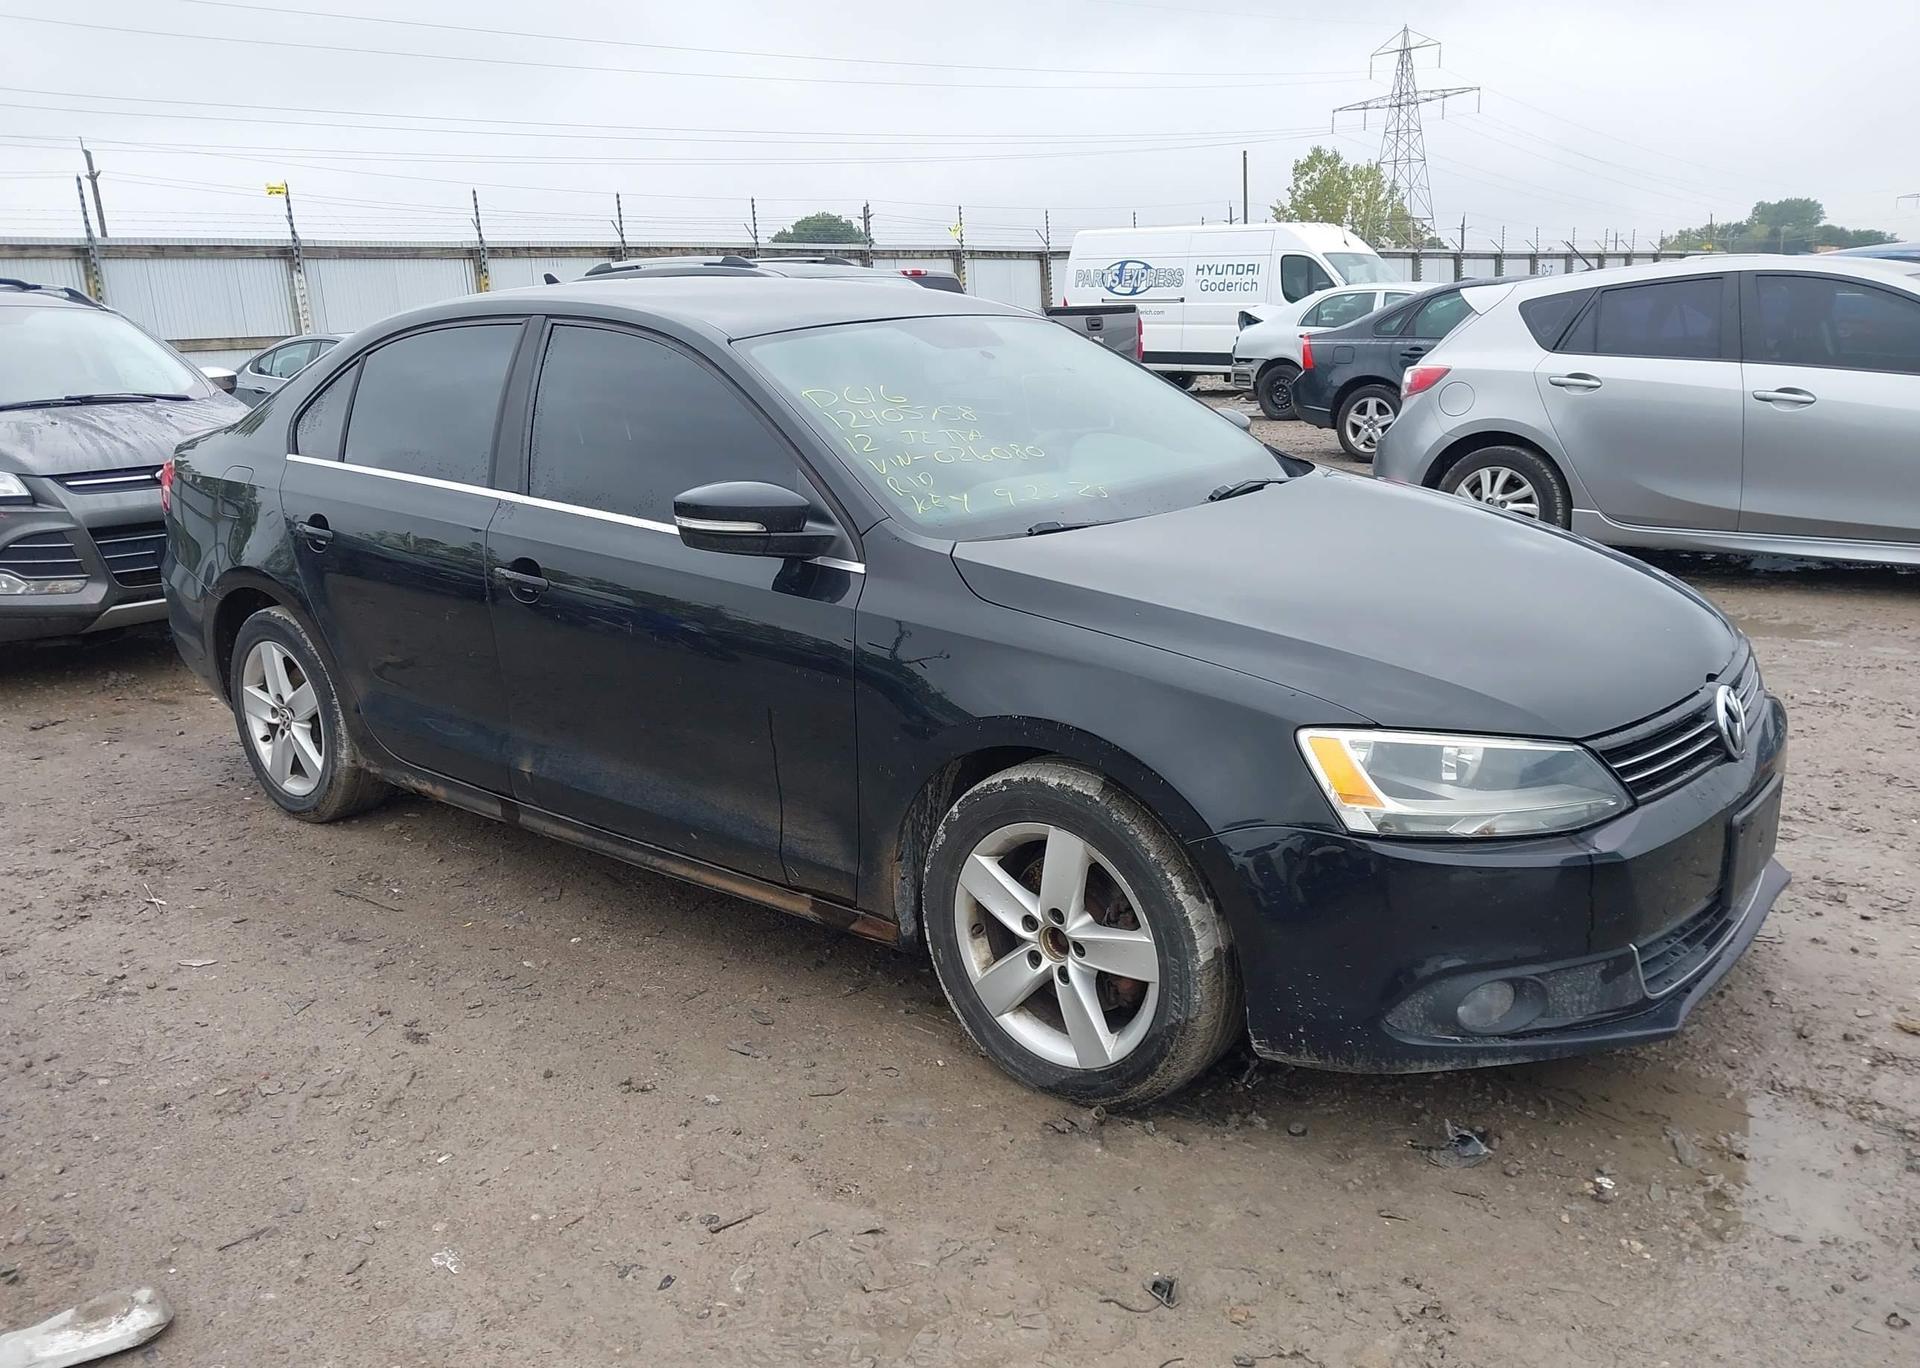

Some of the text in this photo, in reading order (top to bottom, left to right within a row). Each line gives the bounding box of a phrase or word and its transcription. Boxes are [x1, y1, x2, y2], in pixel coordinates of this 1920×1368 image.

[1195, 263, 1261, 276] HYUNDAI
[1074, 267, 1185, 288] PARTS EXPRESS
[1199, 277, 1259, 292] Goderich
